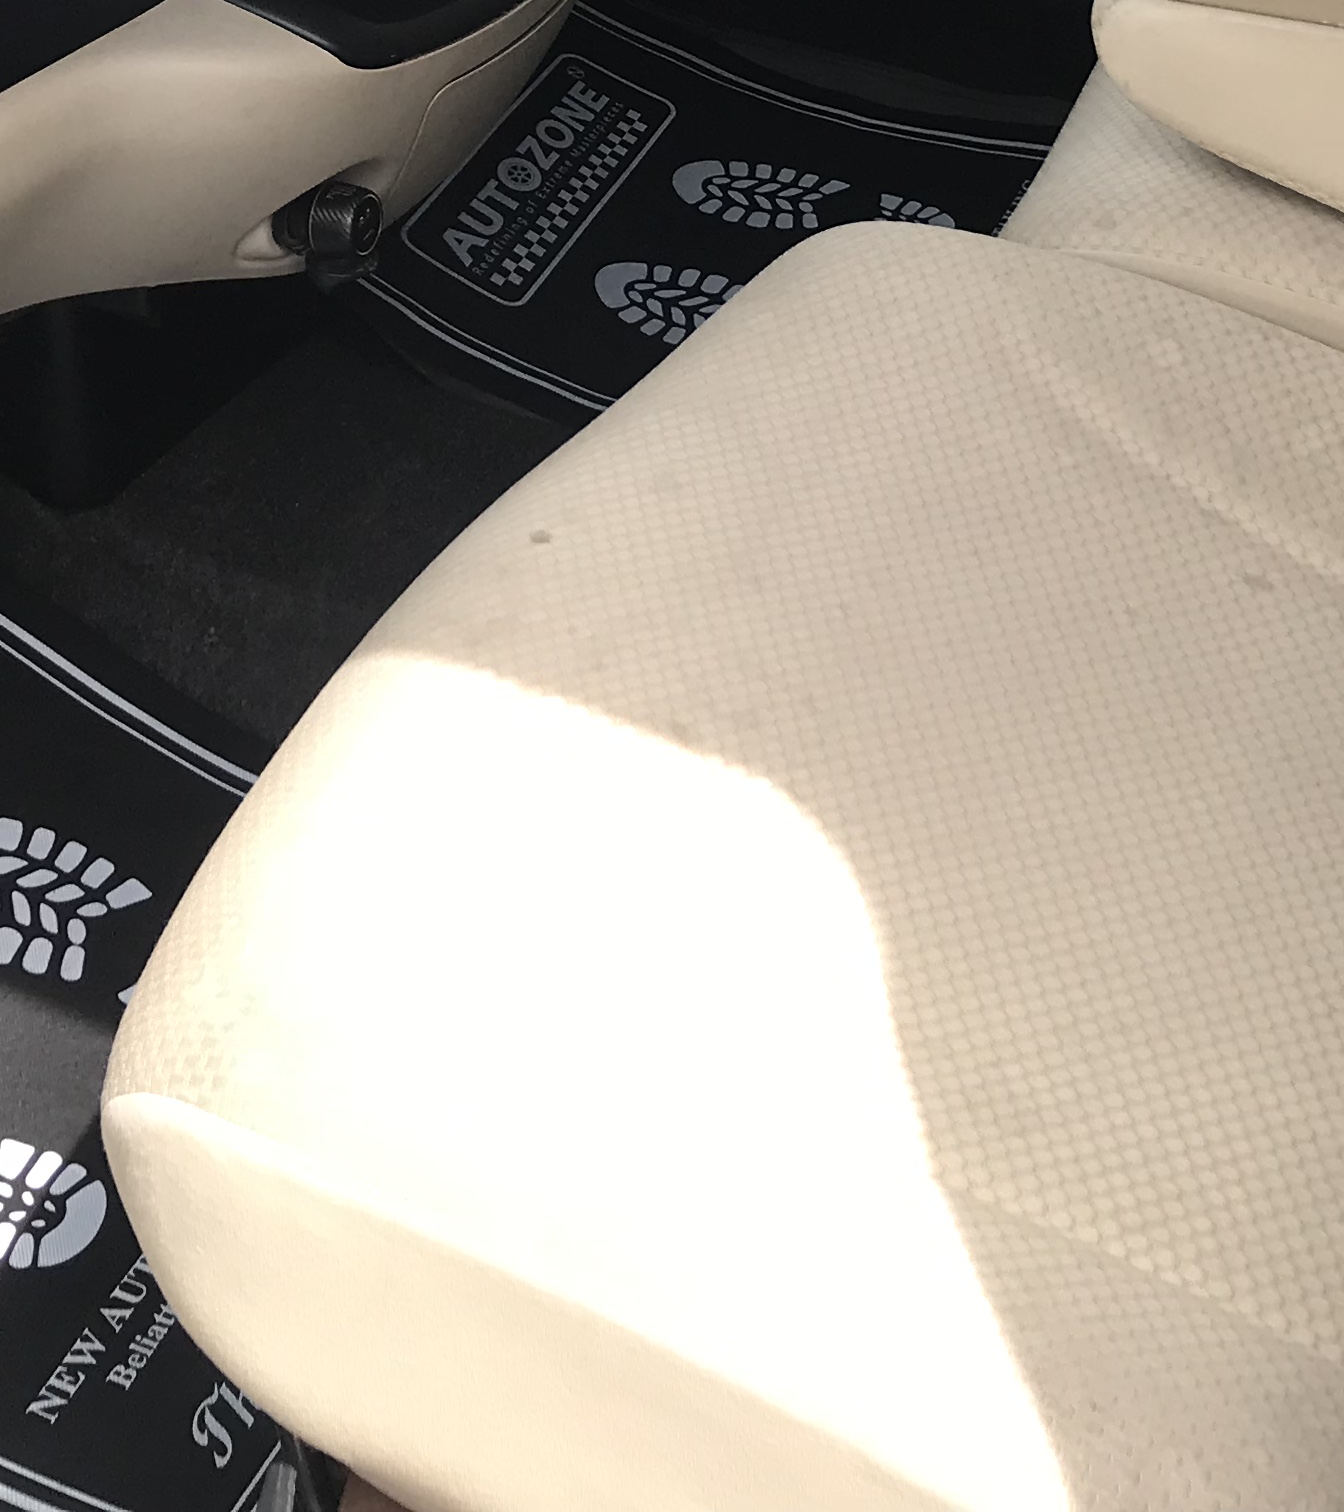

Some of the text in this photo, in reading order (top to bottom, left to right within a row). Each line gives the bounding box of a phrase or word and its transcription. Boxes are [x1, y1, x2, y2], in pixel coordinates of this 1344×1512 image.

[472, 217, 529, 276] Redefining
[526, 199, 539, 214] of
[536, 160, 573, 199] Extreme
[571, 102, 625, 157] Masterpieces
[25, 1253, 155, 1425] NEW AUT
